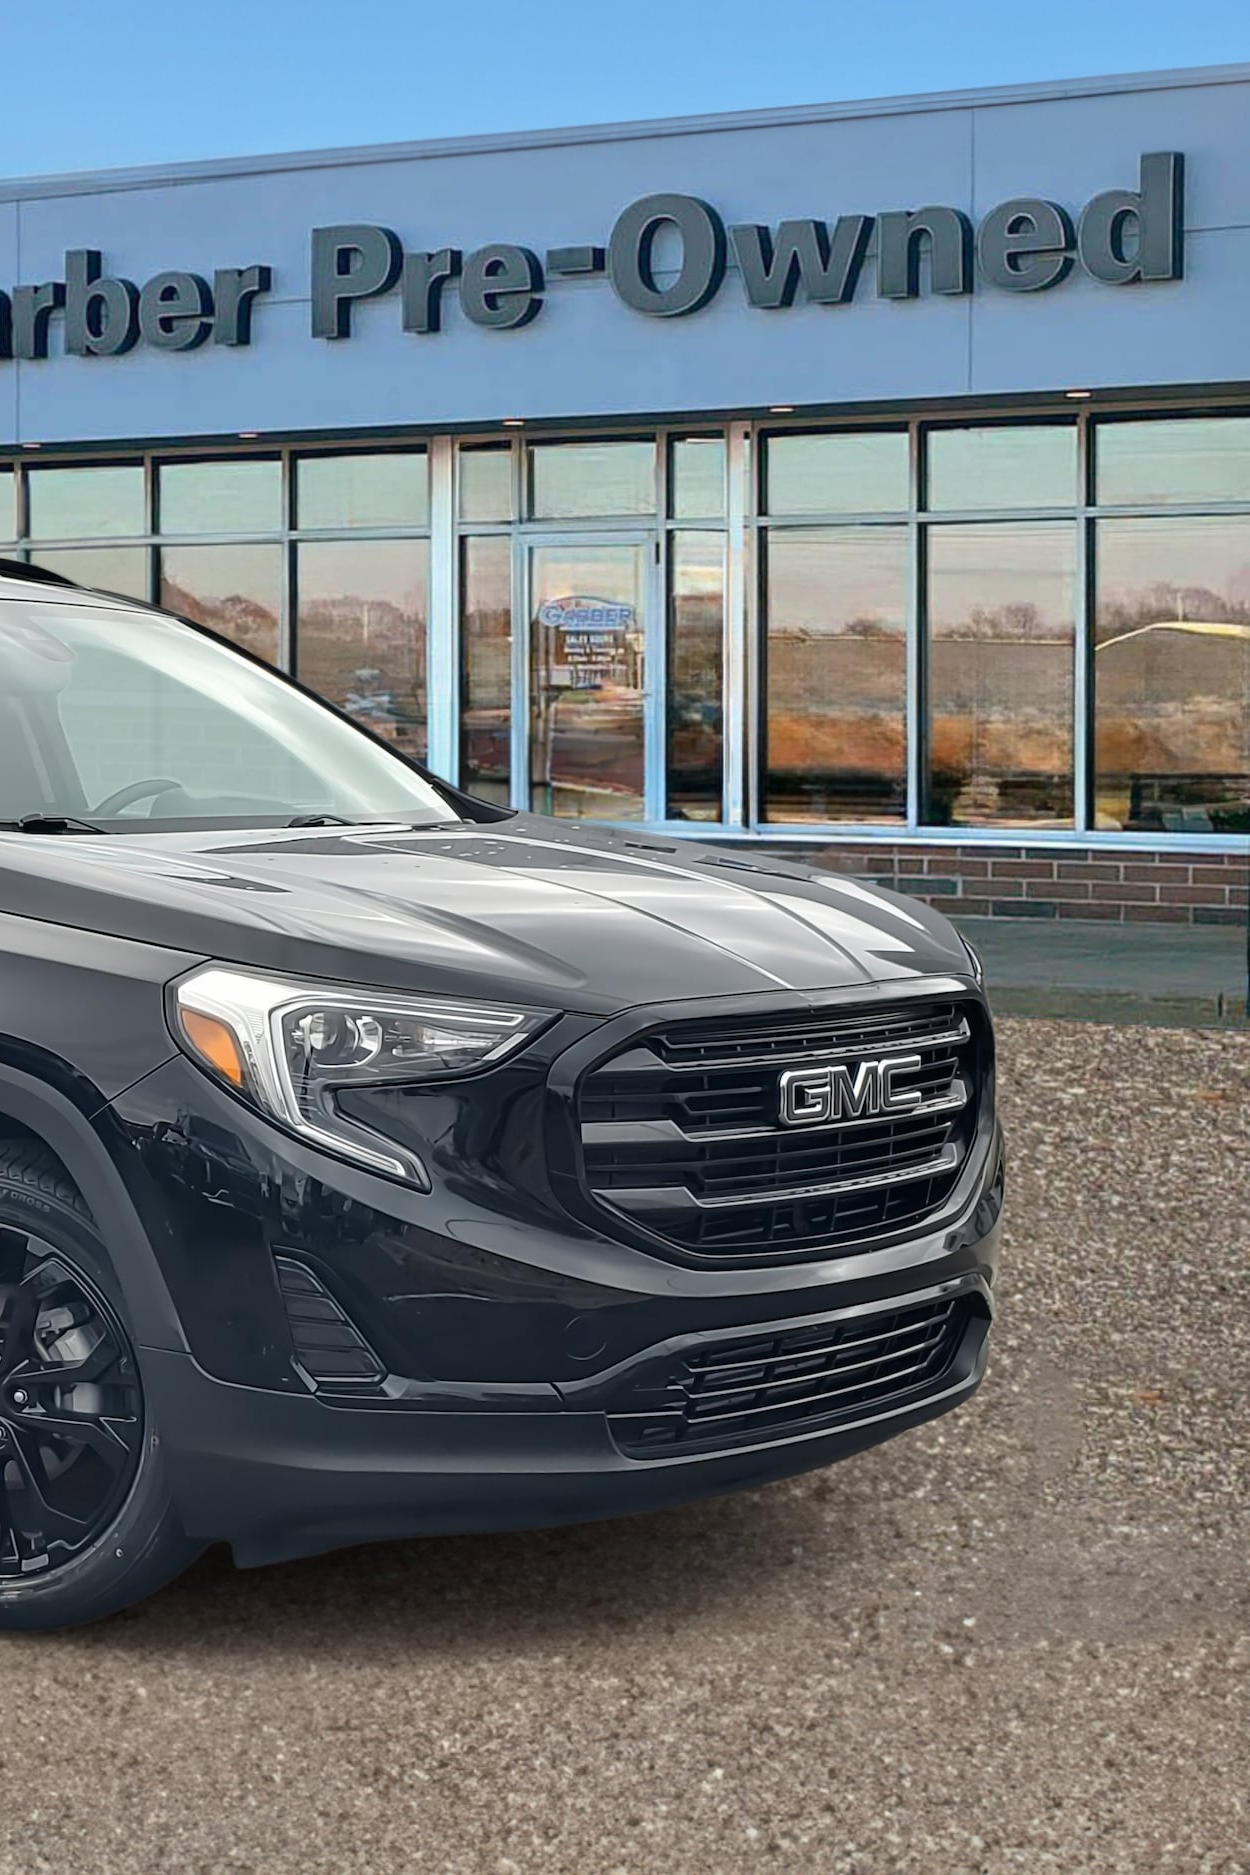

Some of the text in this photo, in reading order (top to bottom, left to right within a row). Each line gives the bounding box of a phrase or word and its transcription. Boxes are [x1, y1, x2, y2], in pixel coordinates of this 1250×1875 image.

[311, 151, 1185, 339] Pre-Owned
[778, 1054, 922, 1126] GMC
[9, 1191, 51, 1213] CROSS
